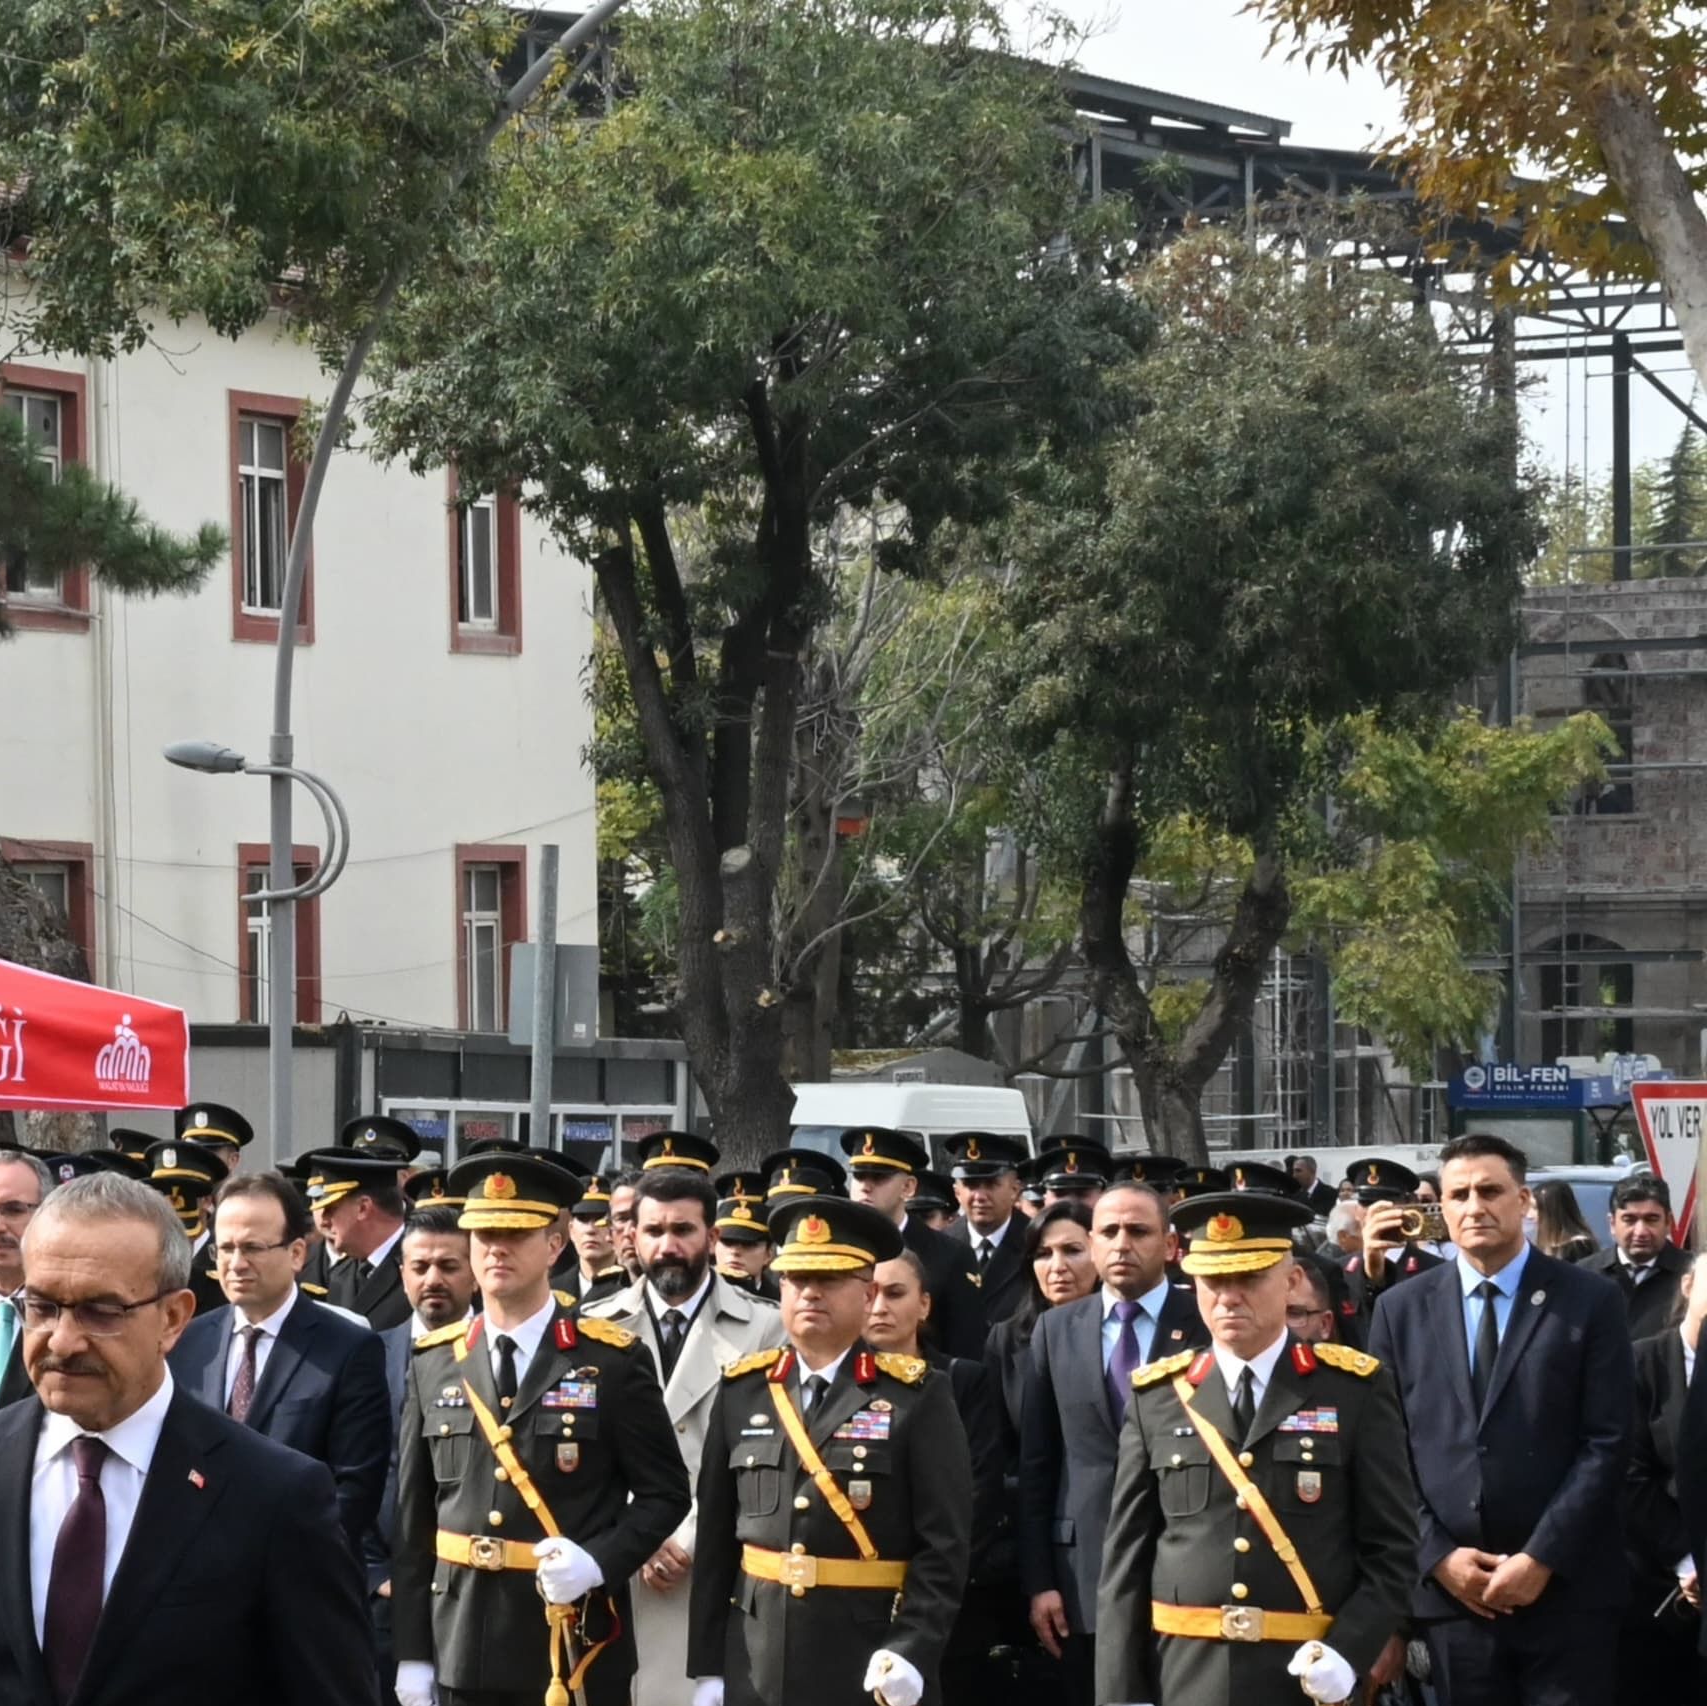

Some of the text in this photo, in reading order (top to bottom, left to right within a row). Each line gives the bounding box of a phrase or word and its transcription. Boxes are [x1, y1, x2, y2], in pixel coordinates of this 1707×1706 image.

[1494, 1063, 1567, 1082] BİL-FEN
[1650, 1105, 1701, 1138] YOL VER
